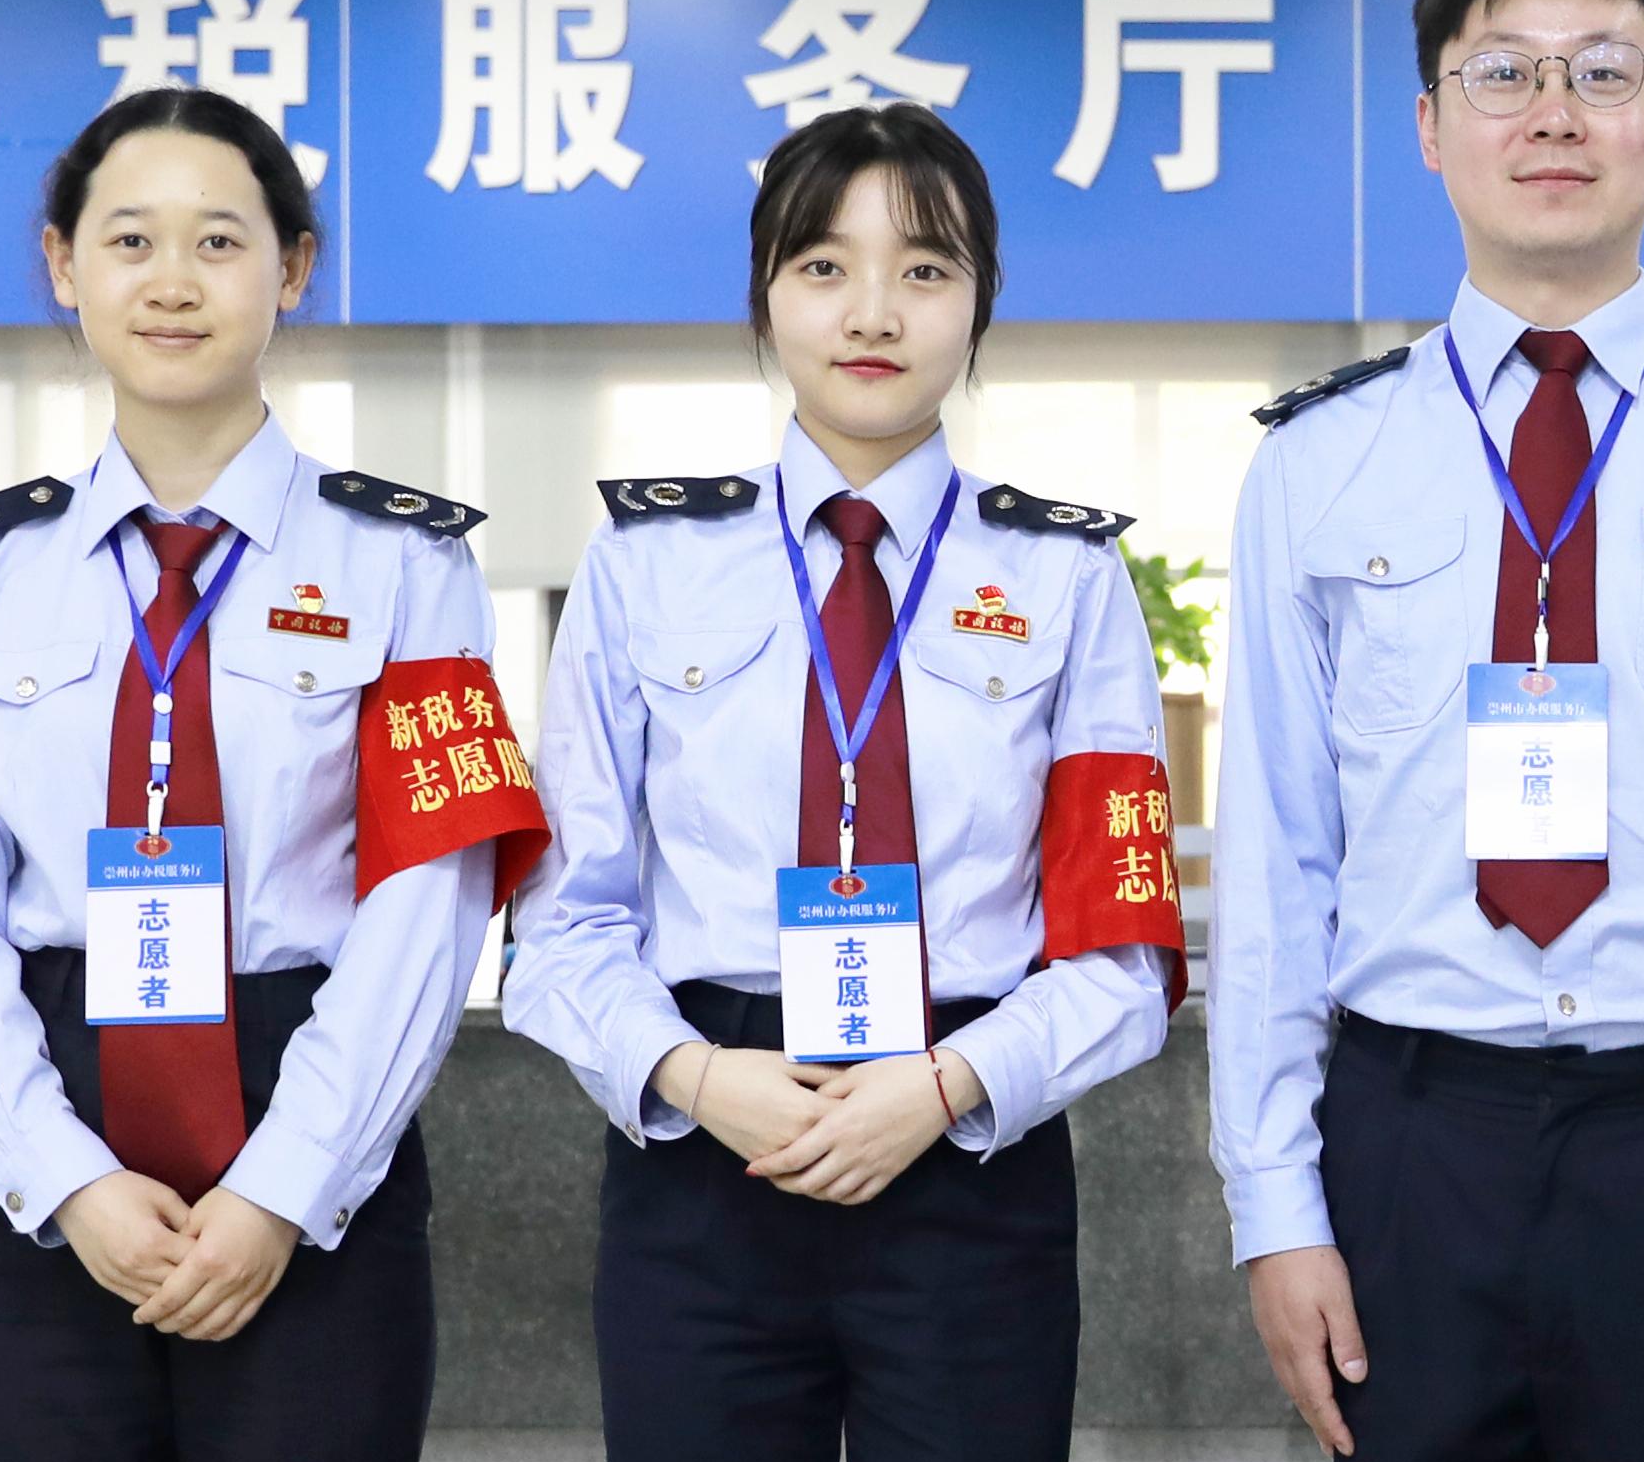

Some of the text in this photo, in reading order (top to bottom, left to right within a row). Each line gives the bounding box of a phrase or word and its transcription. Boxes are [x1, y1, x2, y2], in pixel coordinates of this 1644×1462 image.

[385, 686, 494, 751] 新税务
[1487, 701, 1587, 716] 崇州市办税服务厅
[1521, 737, 1554, 845] 志愿者
[104, 864, 202, 879] 崇州市办税服务厅
[1113, 846, 1178, 903] 志
[799, 902, 898, 918] 崇州市办税服务厅
[137, 899, 170, 1008] 志愿者
[835, 937, 871, 1045] 志愿者
